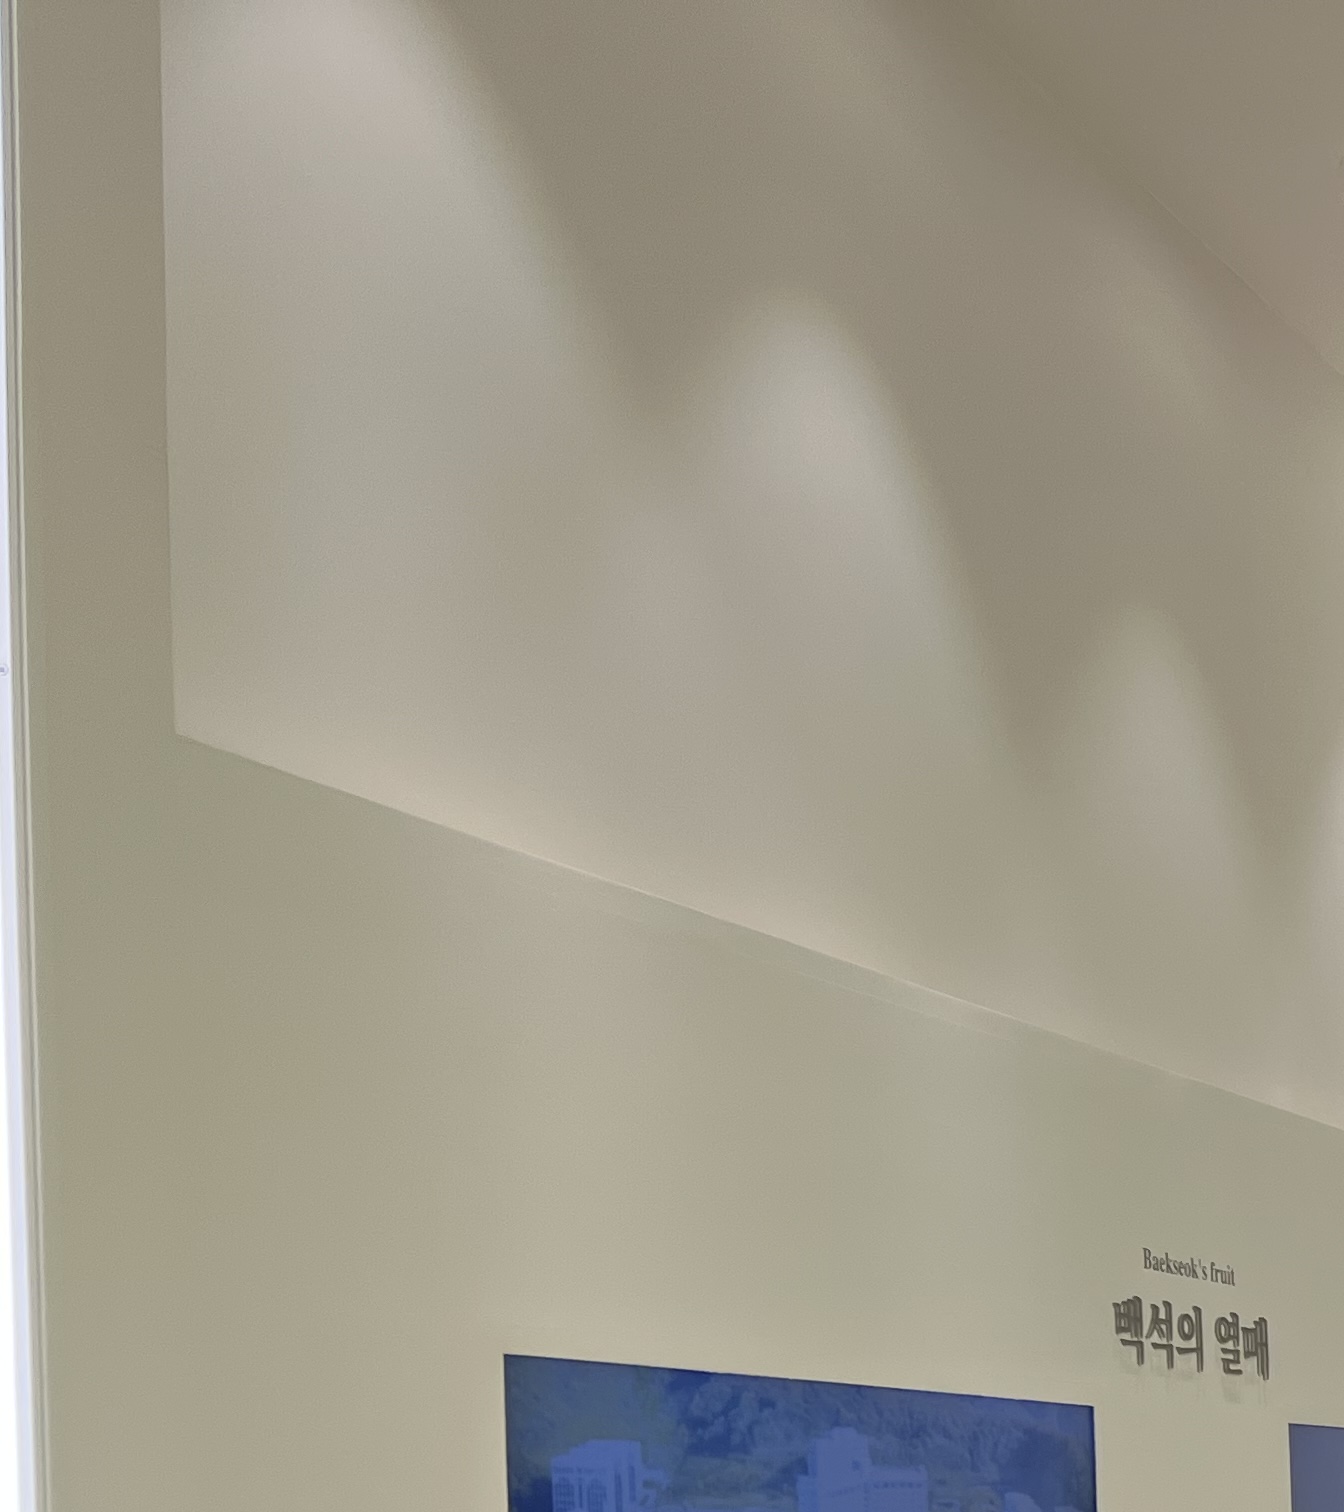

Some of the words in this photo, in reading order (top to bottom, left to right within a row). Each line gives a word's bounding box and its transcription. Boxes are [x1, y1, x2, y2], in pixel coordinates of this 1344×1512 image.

[1142, 1247, 1208, 1281] Baekseok's
[1210, 1262, 1236, 1287] fruit
[1112, 1295, 1204, 1373] 백석의
[1214, 1312, 1270, 1381] 열매
